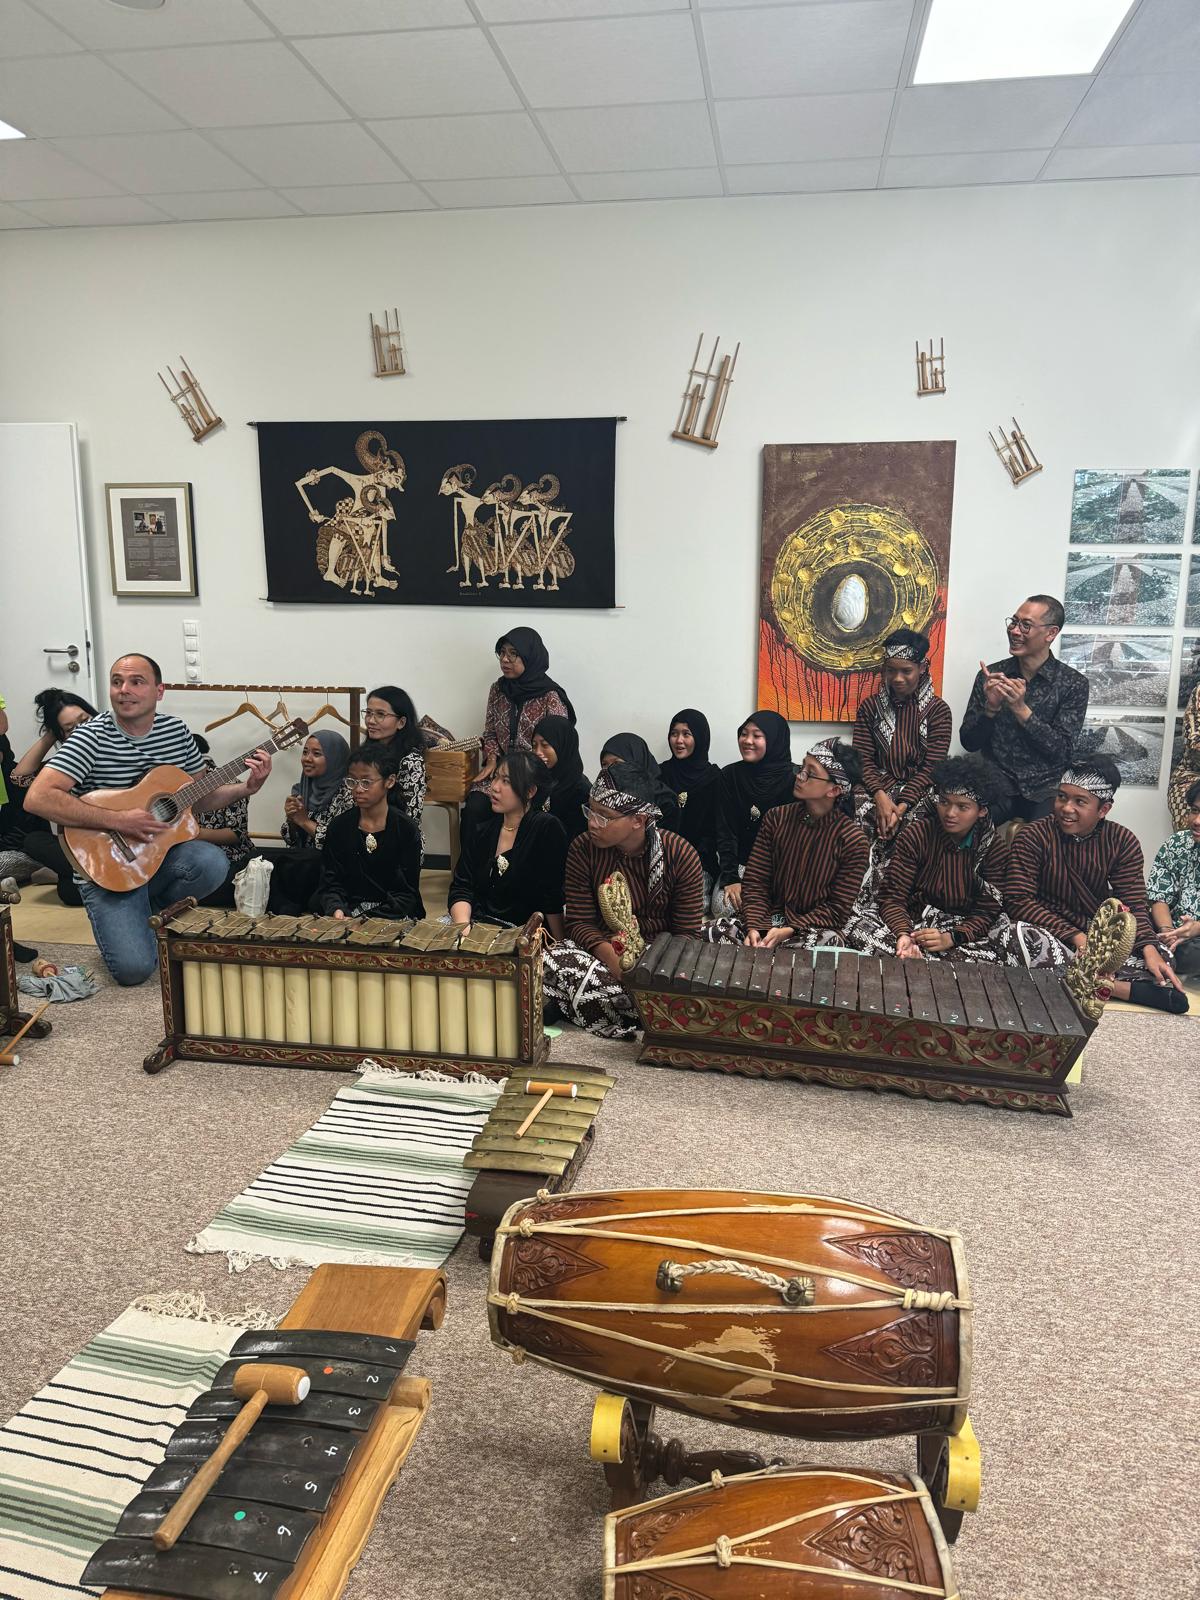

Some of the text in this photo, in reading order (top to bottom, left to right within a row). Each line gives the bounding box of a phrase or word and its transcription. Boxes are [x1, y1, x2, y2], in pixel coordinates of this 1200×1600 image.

[366, 1375, 380, 1384] 2
[348, 1406, 361, 1416] 3
[324, 1445, 339, 1457] 4
[304, 1480, 318, 1494] 5
[277, 1524, 292, 1537] 6
